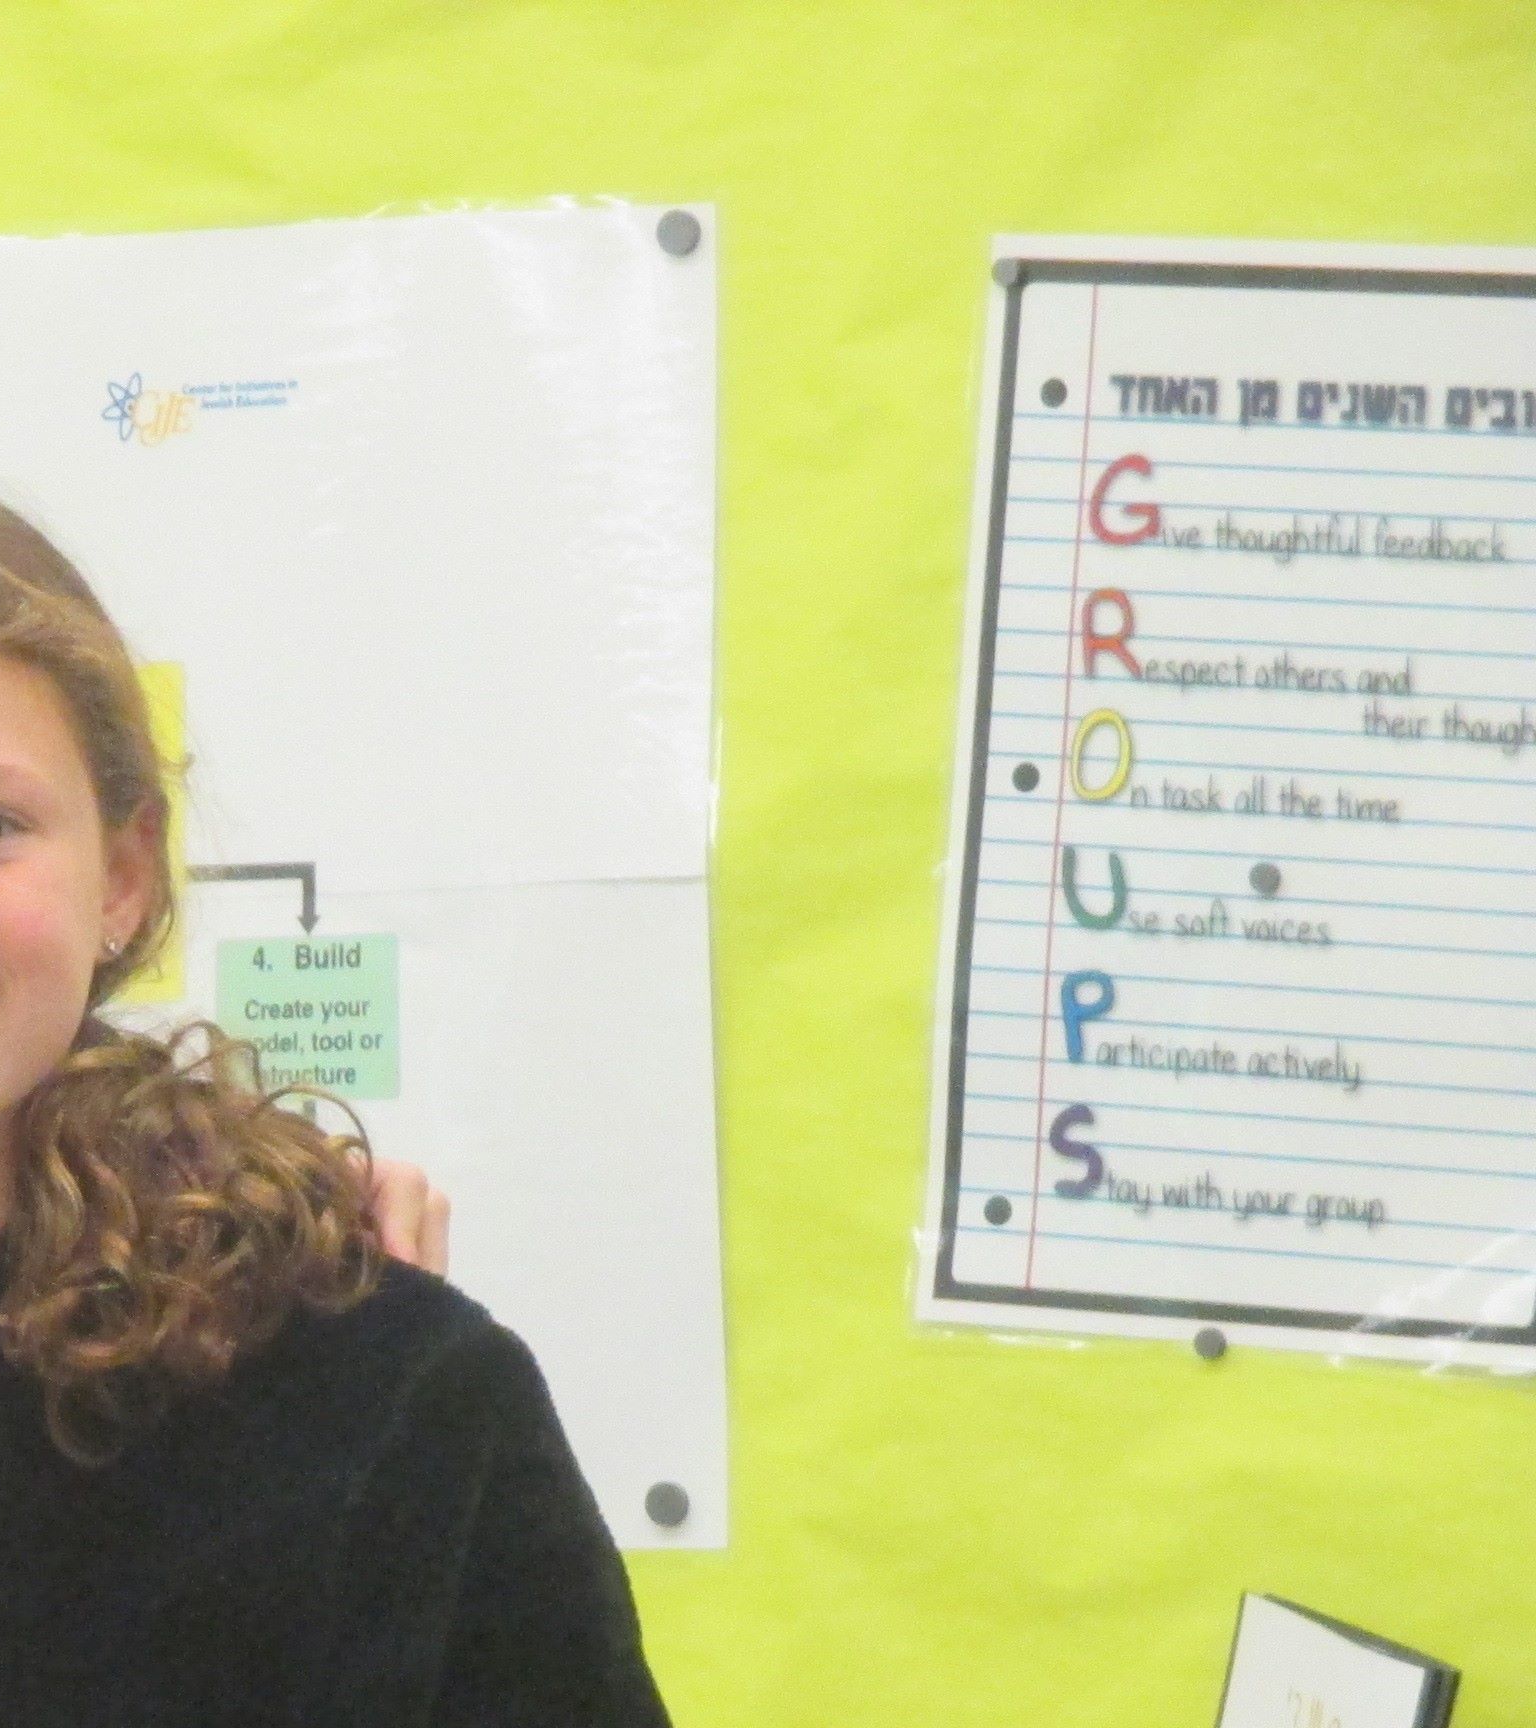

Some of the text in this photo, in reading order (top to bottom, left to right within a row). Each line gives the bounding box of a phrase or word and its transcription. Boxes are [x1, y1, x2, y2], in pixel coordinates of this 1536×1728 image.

[1108, 373, 1219, 416] האחד
[1296, 380, 1428, 425] השנים
[1215, 510, 1362, 569] thoughtful
[1375, 514, 1505, 563] feedback
[1253, 649, 1347, 693] others
[1356, 655, 1413, 695] and
[1362, 698, 1425, 740] their
[1160, 774, 1223, 813] task
[1232, 774, 1266, 816] all
[1279, 777, 1324, 819] the
[1336, 785, 1400, 825] time
[1174, 896, 1231, 940] soft
[1240, 915, 1334, 947] voices
[251, 941, 363, 972] 4. Build
[243, 999, 371, 1024] Create your
[311, 1030, 354, 1053] tool
[359, 1033, 385, 1051] or
[1246, 1038, 1364, 1094] actively
[1161, 1168, 1223, 1212] with
[1232, 1187, 1299, 1224] your
[1305, 1192, 1388, 1230] group
